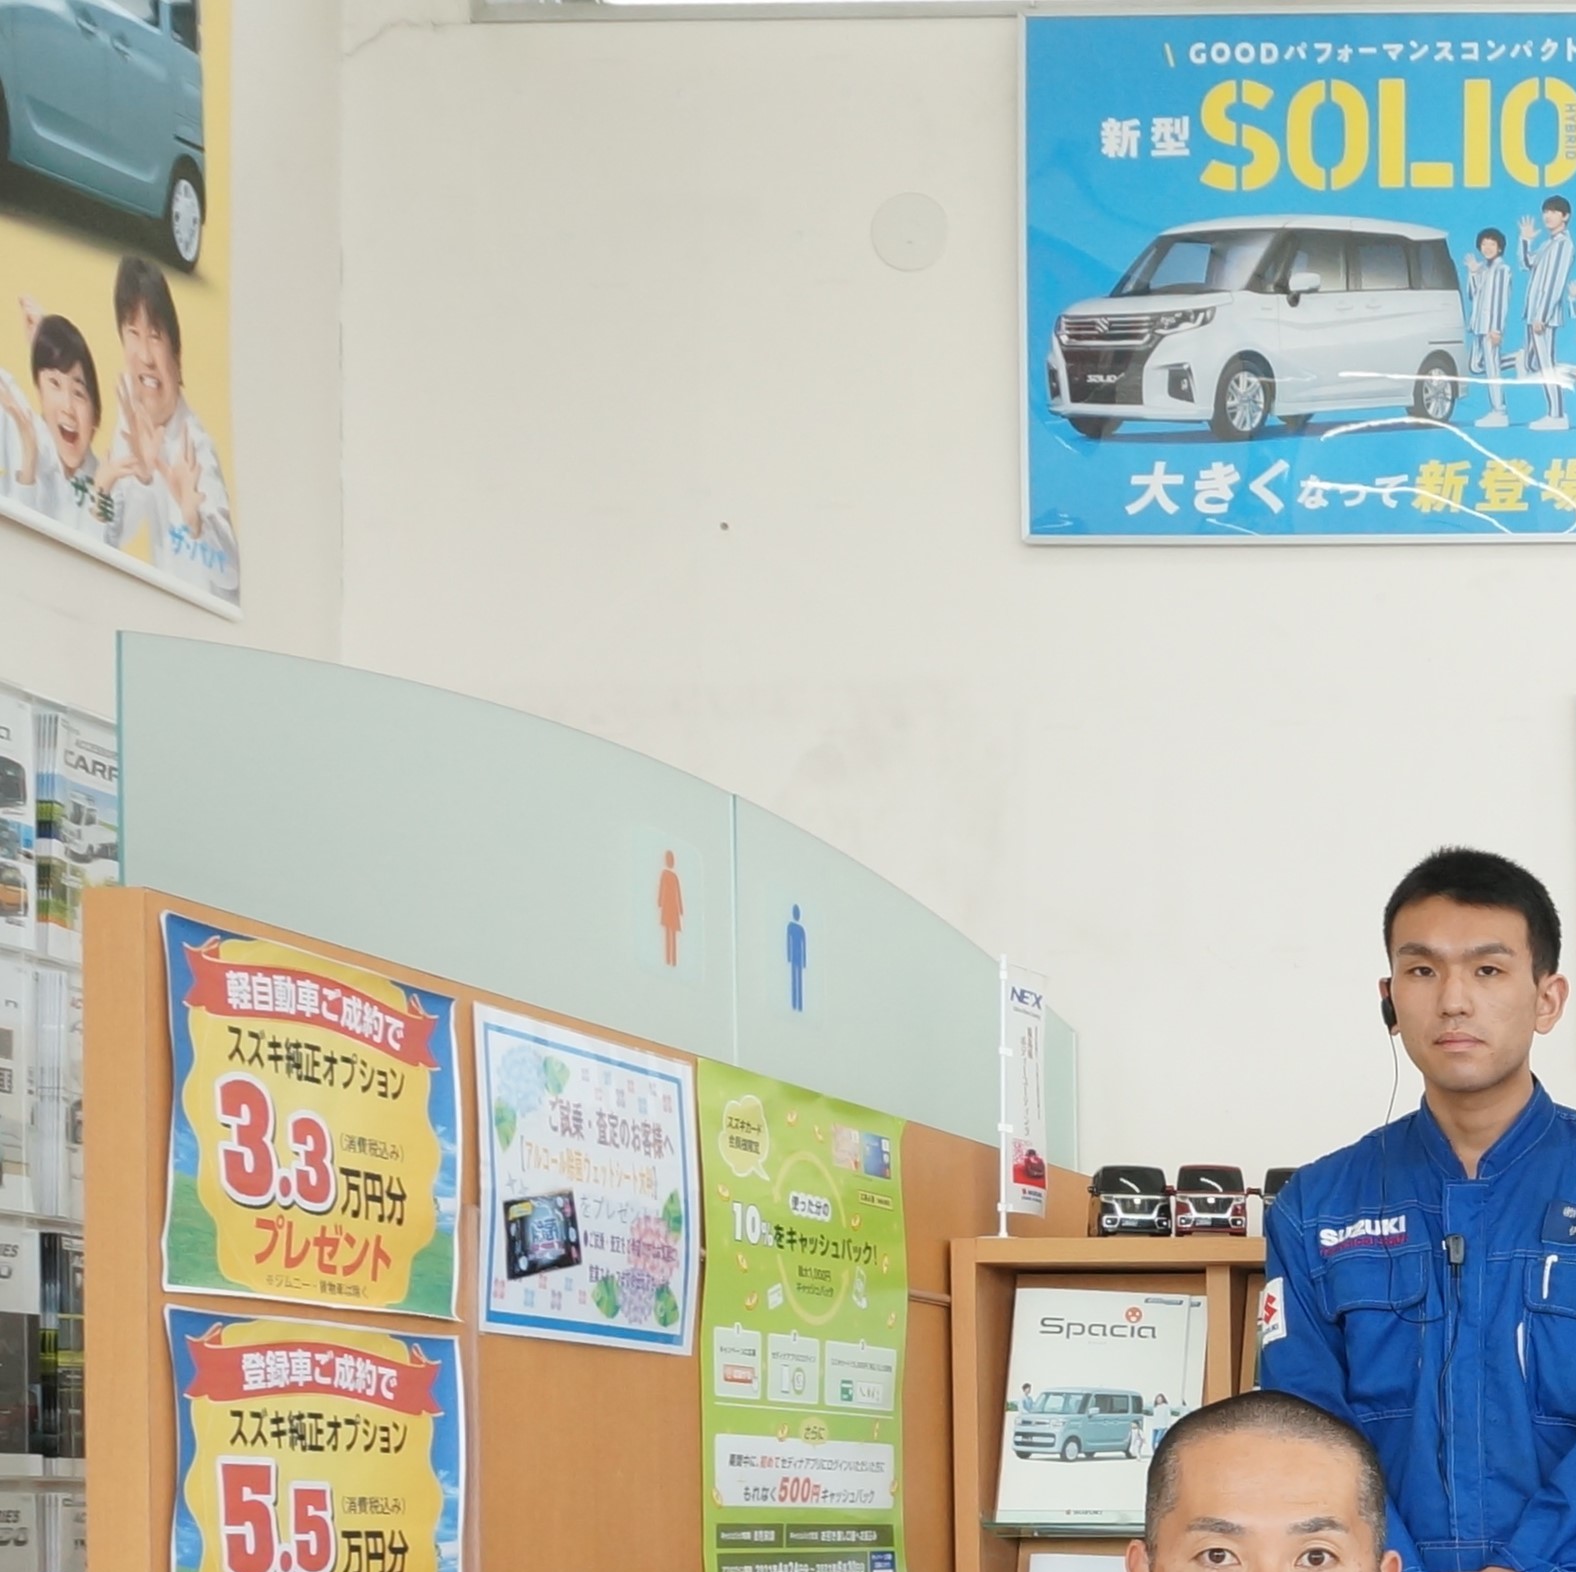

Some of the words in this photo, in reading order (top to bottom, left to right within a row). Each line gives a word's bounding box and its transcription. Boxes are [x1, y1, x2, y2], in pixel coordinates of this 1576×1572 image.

[1101, 115, 1190, 158] 新型
[225, 969, 406, 1051] 軽自動車ご成約で
[226, 1024, 406, 1101] スズキ純正オプション
[215, 1074, 337, 1210] 3.3
[338, 1165, 408, 1227] 万円分
[253, 1213, 392, 1283] プレゼント
[1319, 1214, 1406, 1247] SUZUKI
[1039, 1316, 1157, 1341] Spacia
[241, 1348, 398, 1401] 登録車ご成約で
[229, 1409, 408, 1454] スズキ純正オプション
